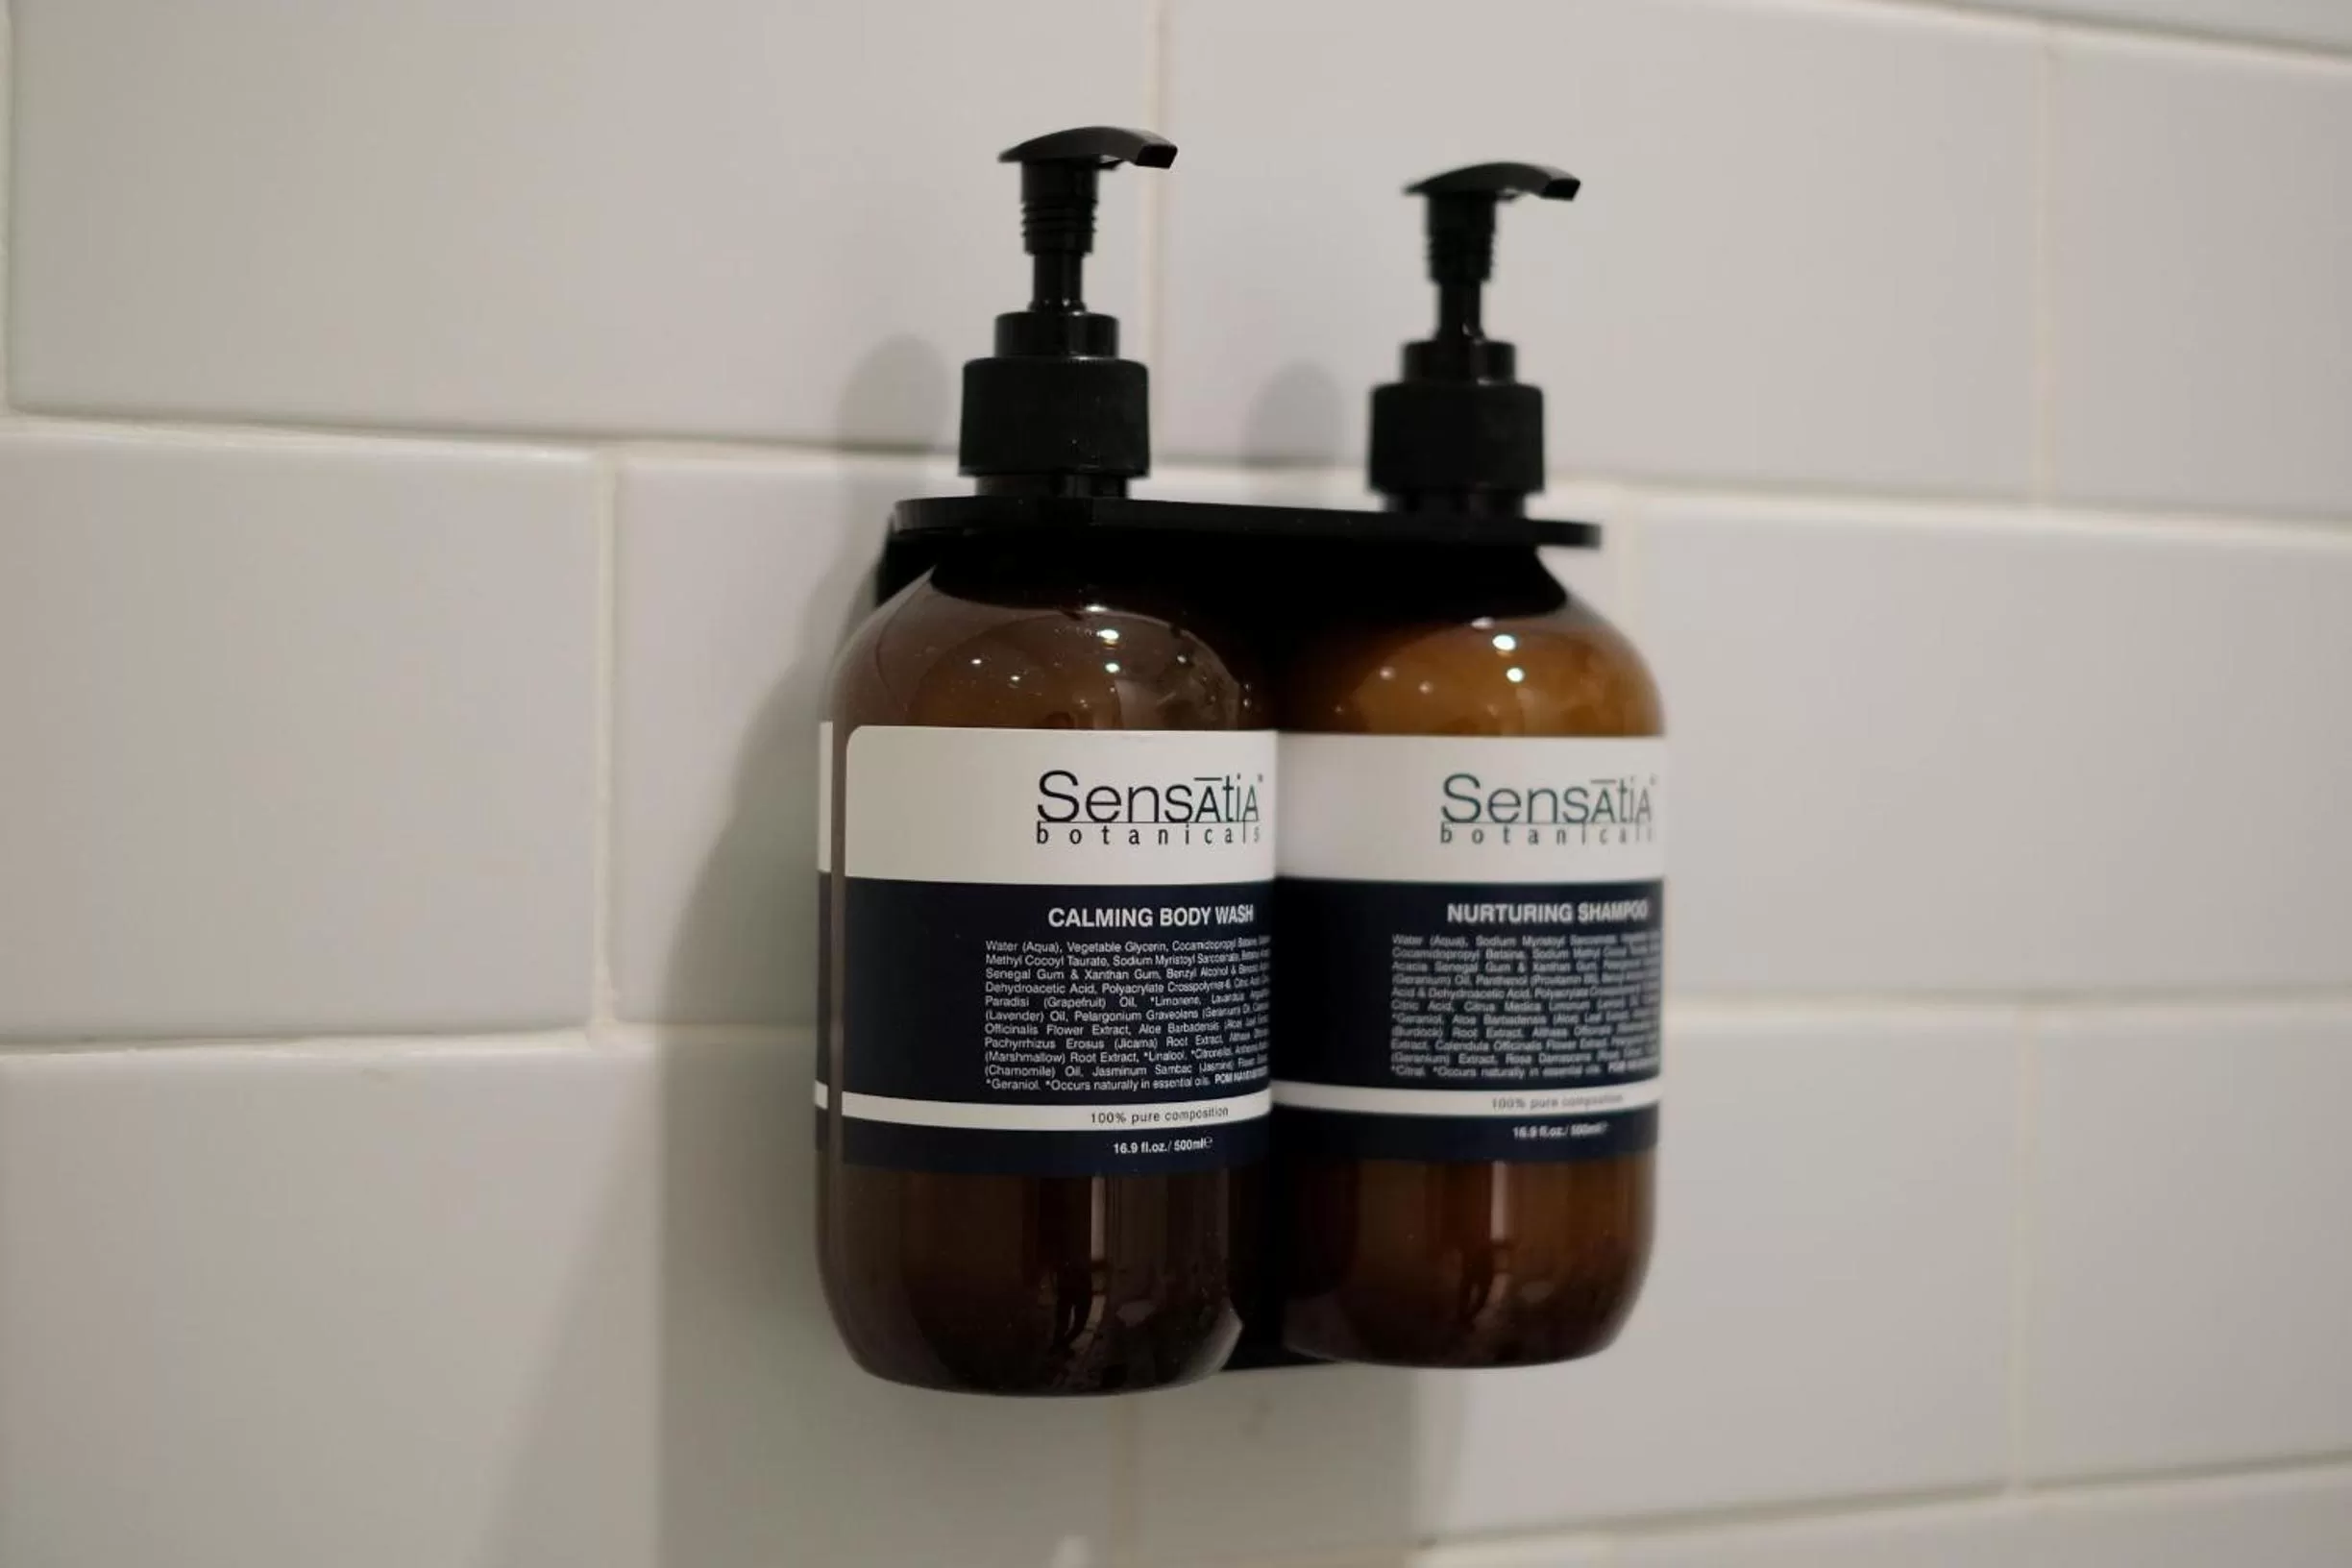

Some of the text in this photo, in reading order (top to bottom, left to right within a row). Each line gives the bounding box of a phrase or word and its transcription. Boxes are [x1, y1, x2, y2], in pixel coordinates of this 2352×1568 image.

[1037, 820, 1261, 845] botanicals
[1048, 903, 1254, 928] CALMING BODY WASH
[1447, 899, 1649, 923] NURTURING SHAMPOO
[1392, 934, 1423, 945] Water
[1475, 935, 1516, 946] Sodium
[985, 940, 1018, 952] Water
[1021, 941, 1063, 954] (Aqua),
[1066, 941, 1122, 955] Vegetable
[1124, 941, 1169, 954] Glycerin,
[1392, 946, 1481, 961] Cocamidopropyl
[1531, 948, 1569, 960] Sodium
[985, 953, 1022, 968] Methyl
[1024, 954, 1065, 968] Cocoyl
[1066, 955, 1110, 967] Taurate,
[1113, 954, 1153, 967] Sodium
[1155, 953, 1195, 968] Myristoyl
[1391, 961, 1428, 972] Acacia
[1434, 961, 1478, 974] Senegal
[1485, 962, 1510, 972] Gum
[1517, 962, 1526, 972] &
[1531, 962, 1571, 972] Xanthan
[985, 967, 1031, 982] Senegal
[1037, 968, 1066, 980] Gum
[1069, 968, 1079, 980] &
[1084, 968, 1130, 980] Xanthan
[1165, 968, 1197, 980] Benzyl
[1200, 965, 1229, 977] Alcohol
[1391, 974, 1451, 986] (Geranium)
[1475, 974, 1528, 986] Panthenol
[985, 981, 1066, 995] Dehydroacetic
[1101, 982, 1164, 996] Polyacrylate
[1391, 988, 1415, 998] Acid
[1417, 988, 1426, 998] &
[1428, 988, 1505, 1002] Dehydroacetic
[985, 995, 1030, 1007] Paradisi
[1043, 996, 1106, 1009] (Grapefruit)
[1391, 1000, 1420, 1012] Citric
[1463, 1001, 1496, 1013] Citrus
[1504, 1001, 1541, 1012] Medica
[985, 1010, 1044, 1022] (Lavender)
[1049, 1010, 1068, 1022] Oil,
[1074, 1010, 1142, 1024] Pelargonium
[1145, 1009, 1199, 1021] Graveolens
[1452, 1015, 1477, 1025] Aloe
[1483, 1015, 1547, 1026] Barbadensis
[985, 1022, 1039, 1035] Officinalis
[1046, 1024, 1084, 1036] Flower
[1091, 1024, 1132, 1036] Extract,
[1139, 1023, 1162, 1035] Aloe
[1167, 1020, 1220, 1033] Barbadensis
[1391, 1025, 1443, 1038] (Burdock)
[1452, 1027, 1478, 1039] Root
[985, 1037, 1056, 1051] Pachyrrhizus
[1066, 1038, 1105, 1049] Erosus
[1114, 1038, 1158, 1050] (Jicama)
[1165, 1036, 1188, 1047] Root
[1434, 1040, 1489, 1051] Calendula
[1493, 1041, 1542, 1052] Officinalis
[985, 1050, 1066, 1065] (Marshmallow)
[1069, 1051, 1096, 1063] Root
[1099, 1051, 1139, 1064] Extract,
[1391, 1052, 1450, 1066] (Geranium)
[1506, 1053, 1531, 1065] Rosa
[985, 1064, 1056, 1078] (Chamomile)
[1092, 1066, 1147, 1077] Jasminum
[1155, 1064, 1192, 1075] Sambac
[1481, 1066, 1525, 1080] naturally
[1093, 1078, 1139, 1092] naturally
[1140, 1077, 1150, 1090] in
[1152, 1076, 1192, 1089] essential
[1491, 1097, 1526, 1109] 100%
[1530, 1097, 1558, 1110] pure
[1090, 1107, 1229, 1125] 100% pure composition
[1512, 1125, 1537, 1139] 16.9
[1114, 1141, 1139, 1154] 16.9
